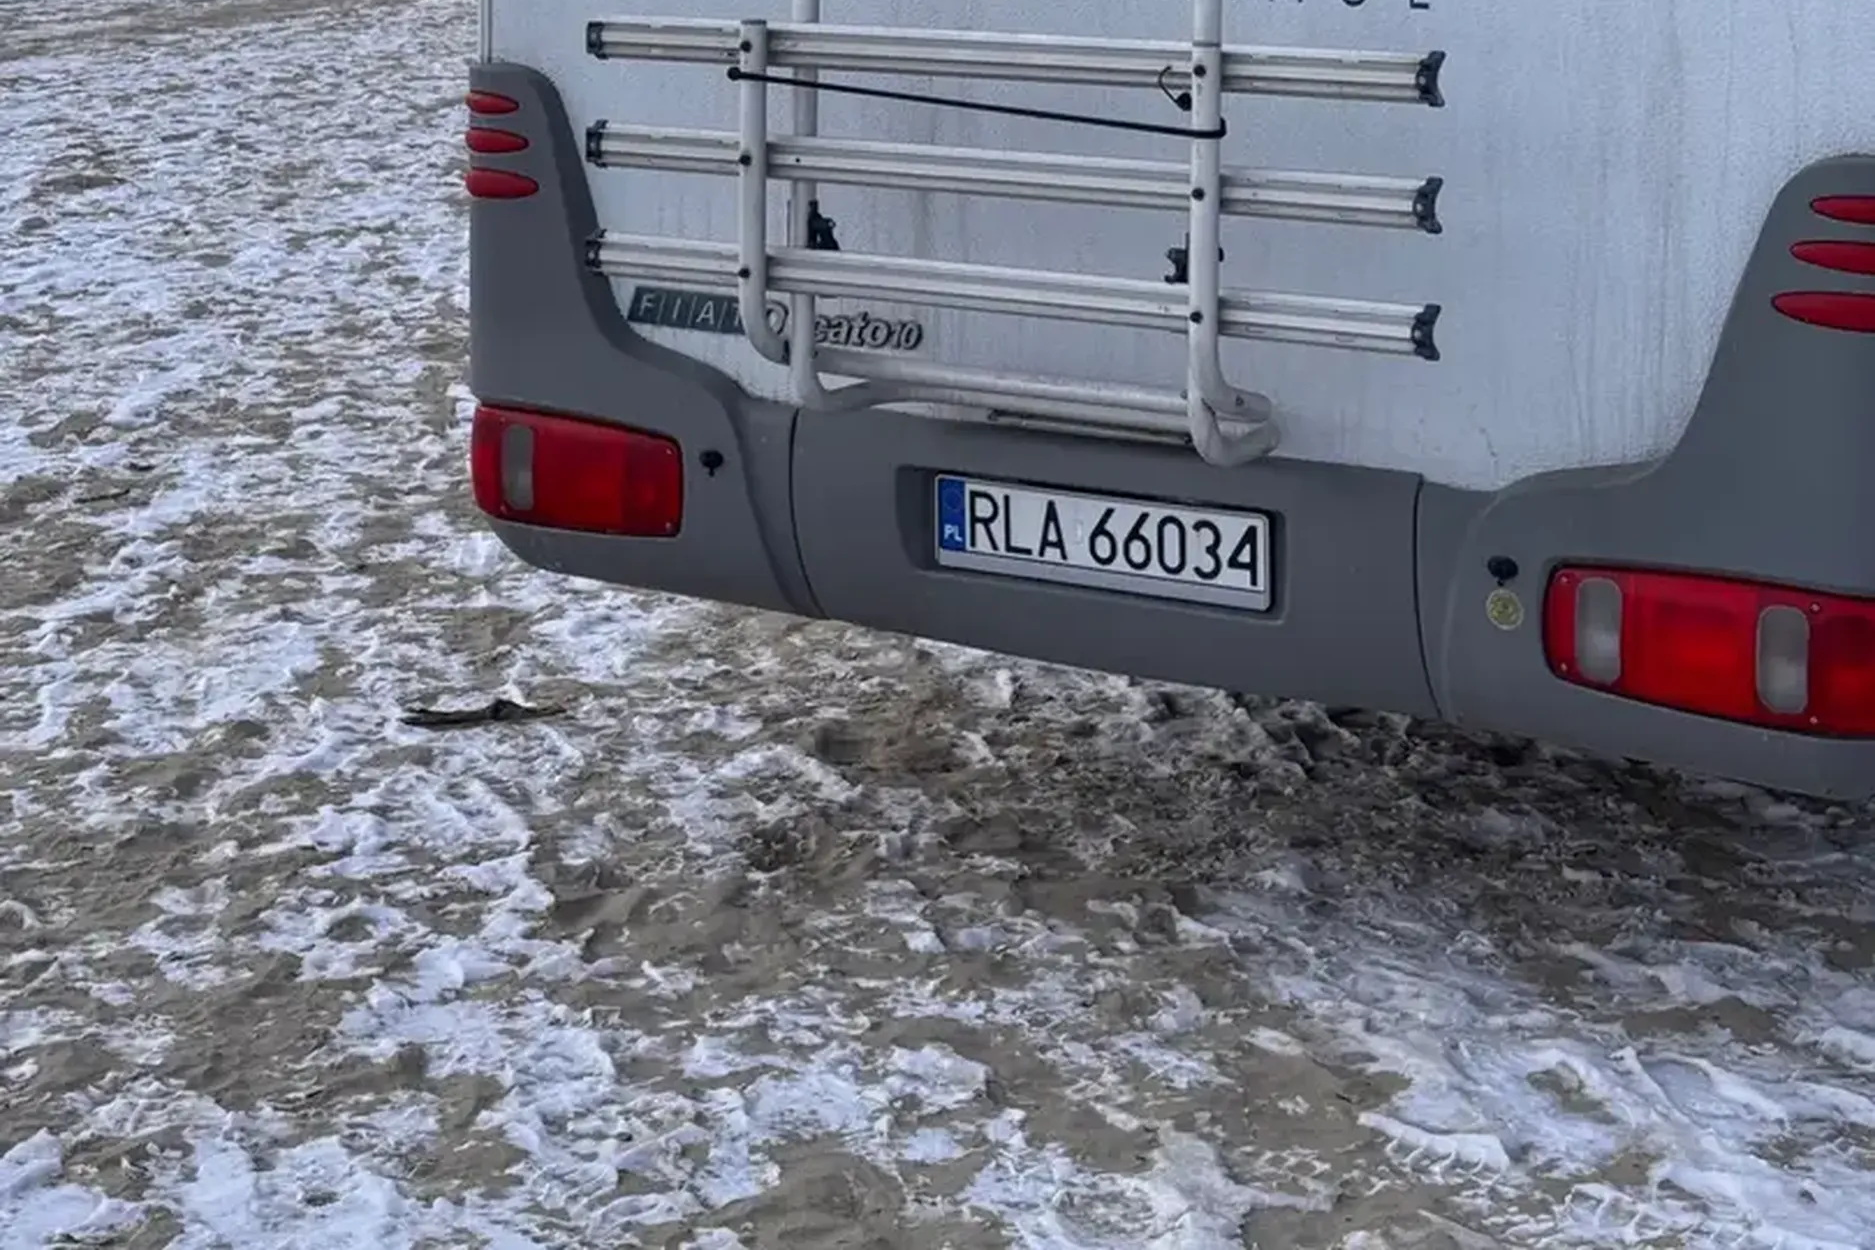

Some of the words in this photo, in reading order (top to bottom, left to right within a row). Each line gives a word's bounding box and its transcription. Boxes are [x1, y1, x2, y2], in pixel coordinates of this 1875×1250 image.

[944, 524, 963, 542] PL
[969, 490, 1068, 561] RLA
[1089, 507, 1258, 587] 66034
